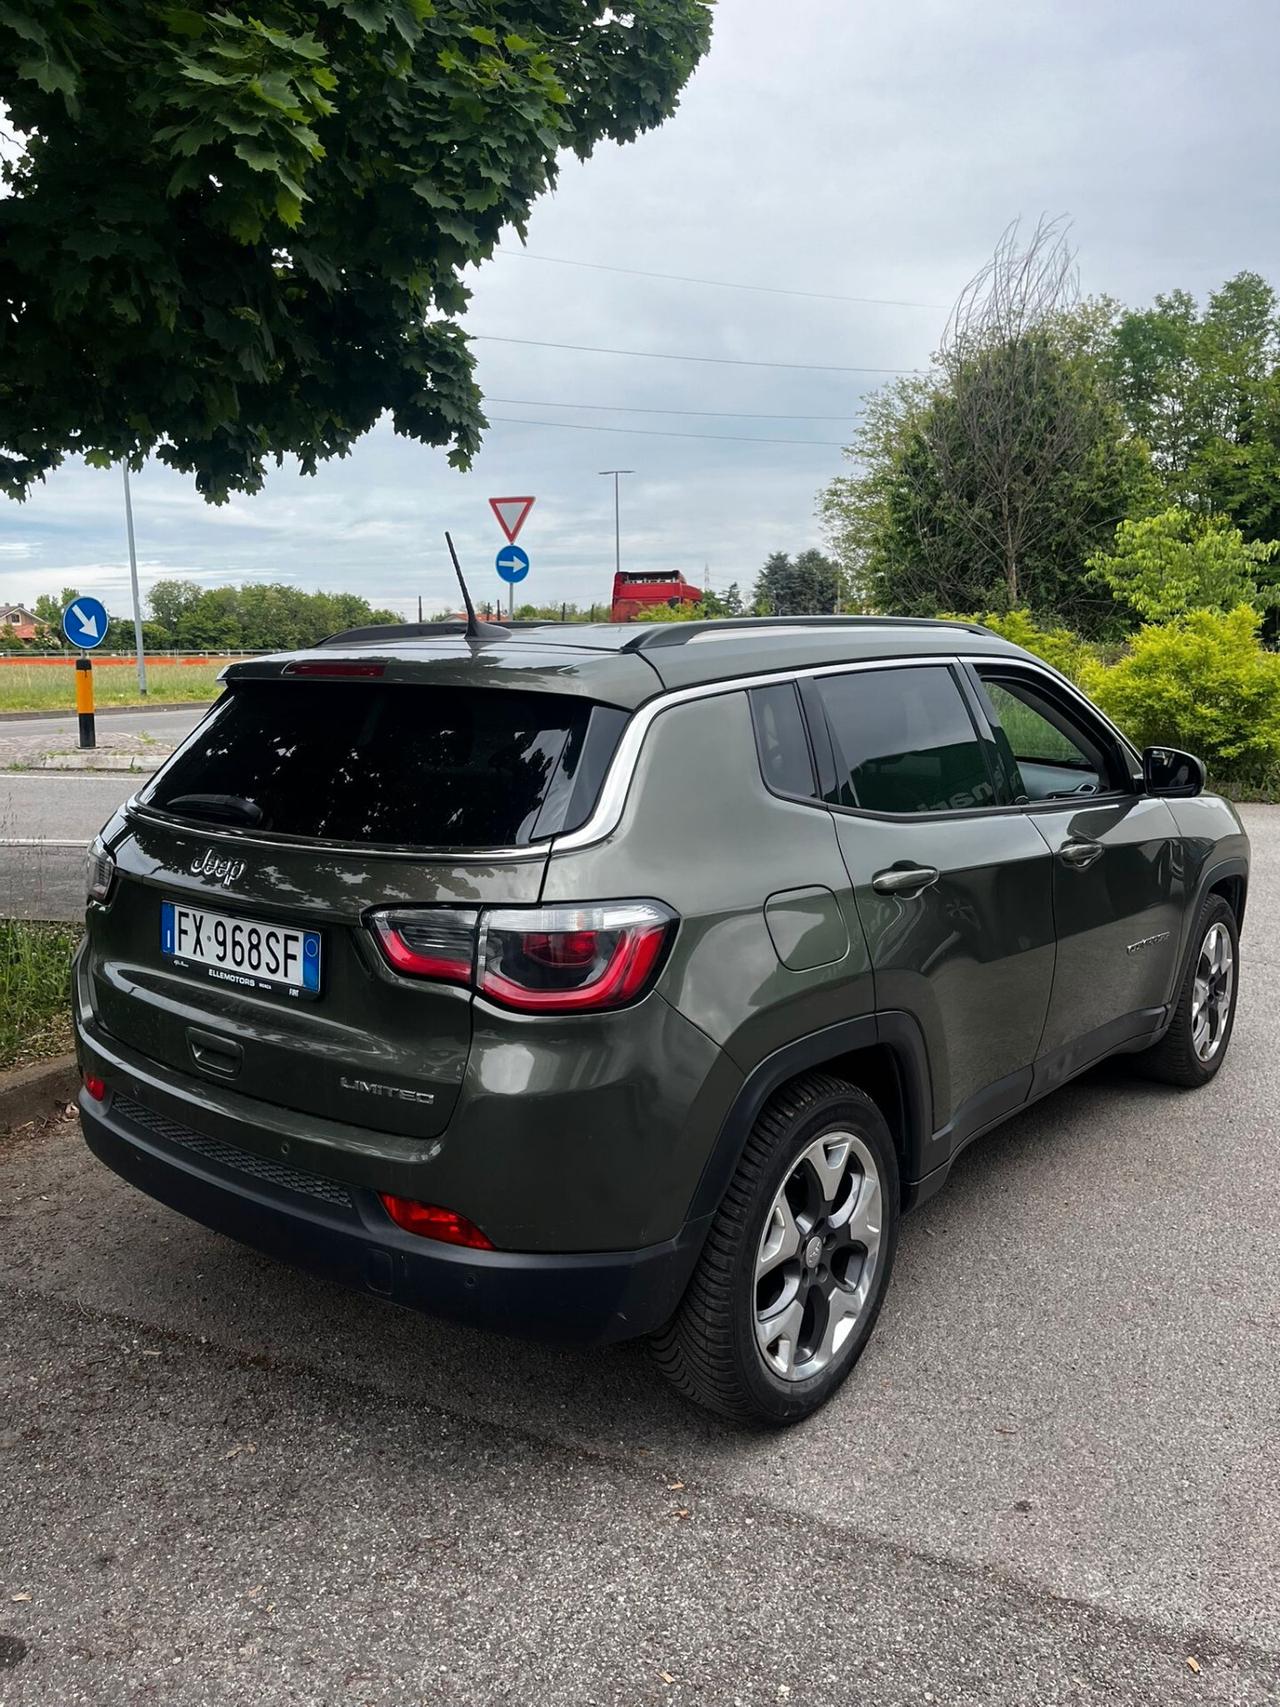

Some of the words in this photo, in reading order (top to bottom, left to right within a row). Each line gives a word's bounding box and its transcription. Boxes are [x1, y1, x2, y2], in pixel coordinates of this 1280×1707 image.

[190, 848, 245, 886] Jeep
[208, 968, 255, 987] ELLEMOTORS
[340, 1076, 434, 1105] LIMITED
